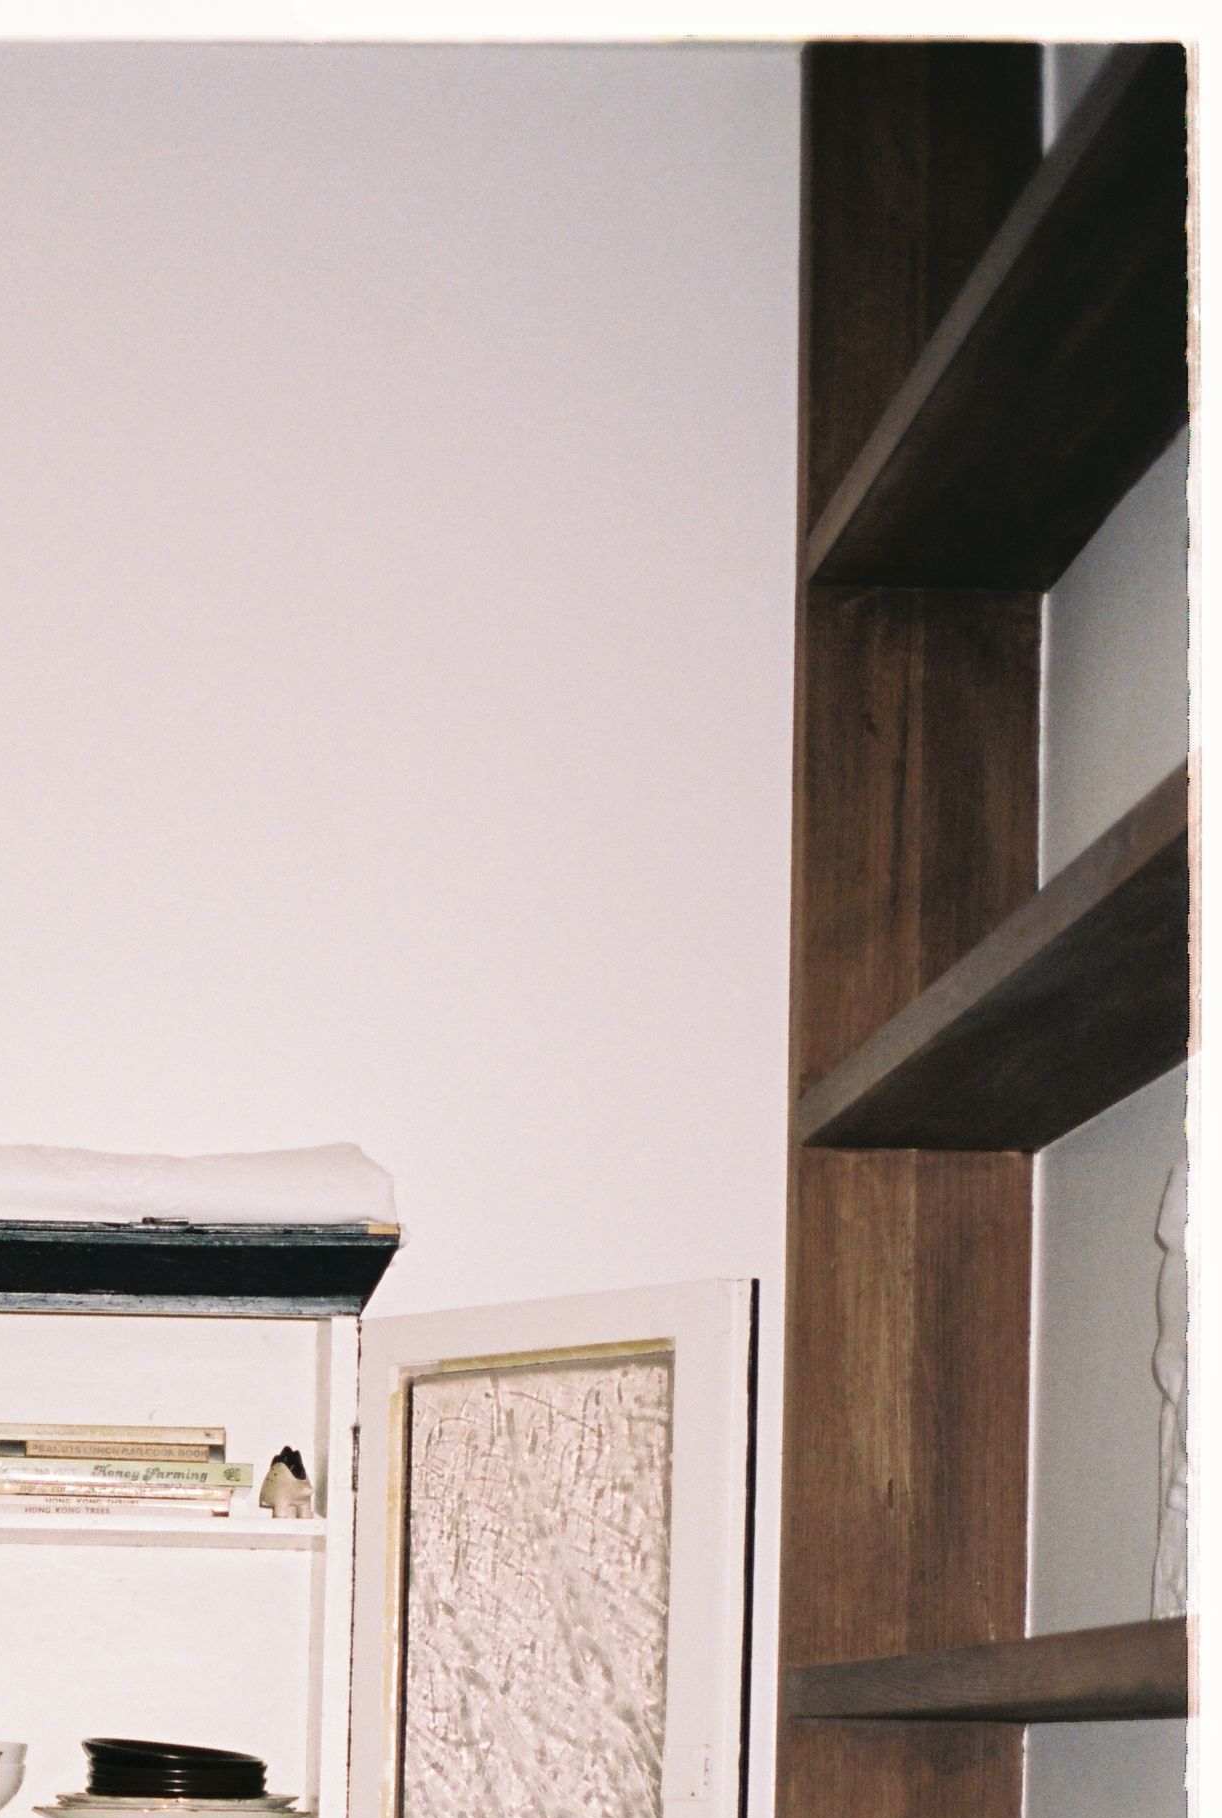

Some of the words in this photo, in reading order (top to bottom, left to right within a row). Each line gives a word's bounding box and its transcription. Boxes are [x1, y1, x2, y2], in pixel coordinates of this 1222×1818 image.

[32, 1443, 81, 1454] PEANUTS
[83, 1445, 120, 1455] LUNCH
[143, 1448, 176, 1457] COOK
[177, 1449, 209, 1458] BOOK
[90, 1463, 139, 1481] Honey
[142, 1466, 208, 1482] Farming
[24, 1506, 51, 1514] HONG
[55, 1506, 81, 1514] KONG
